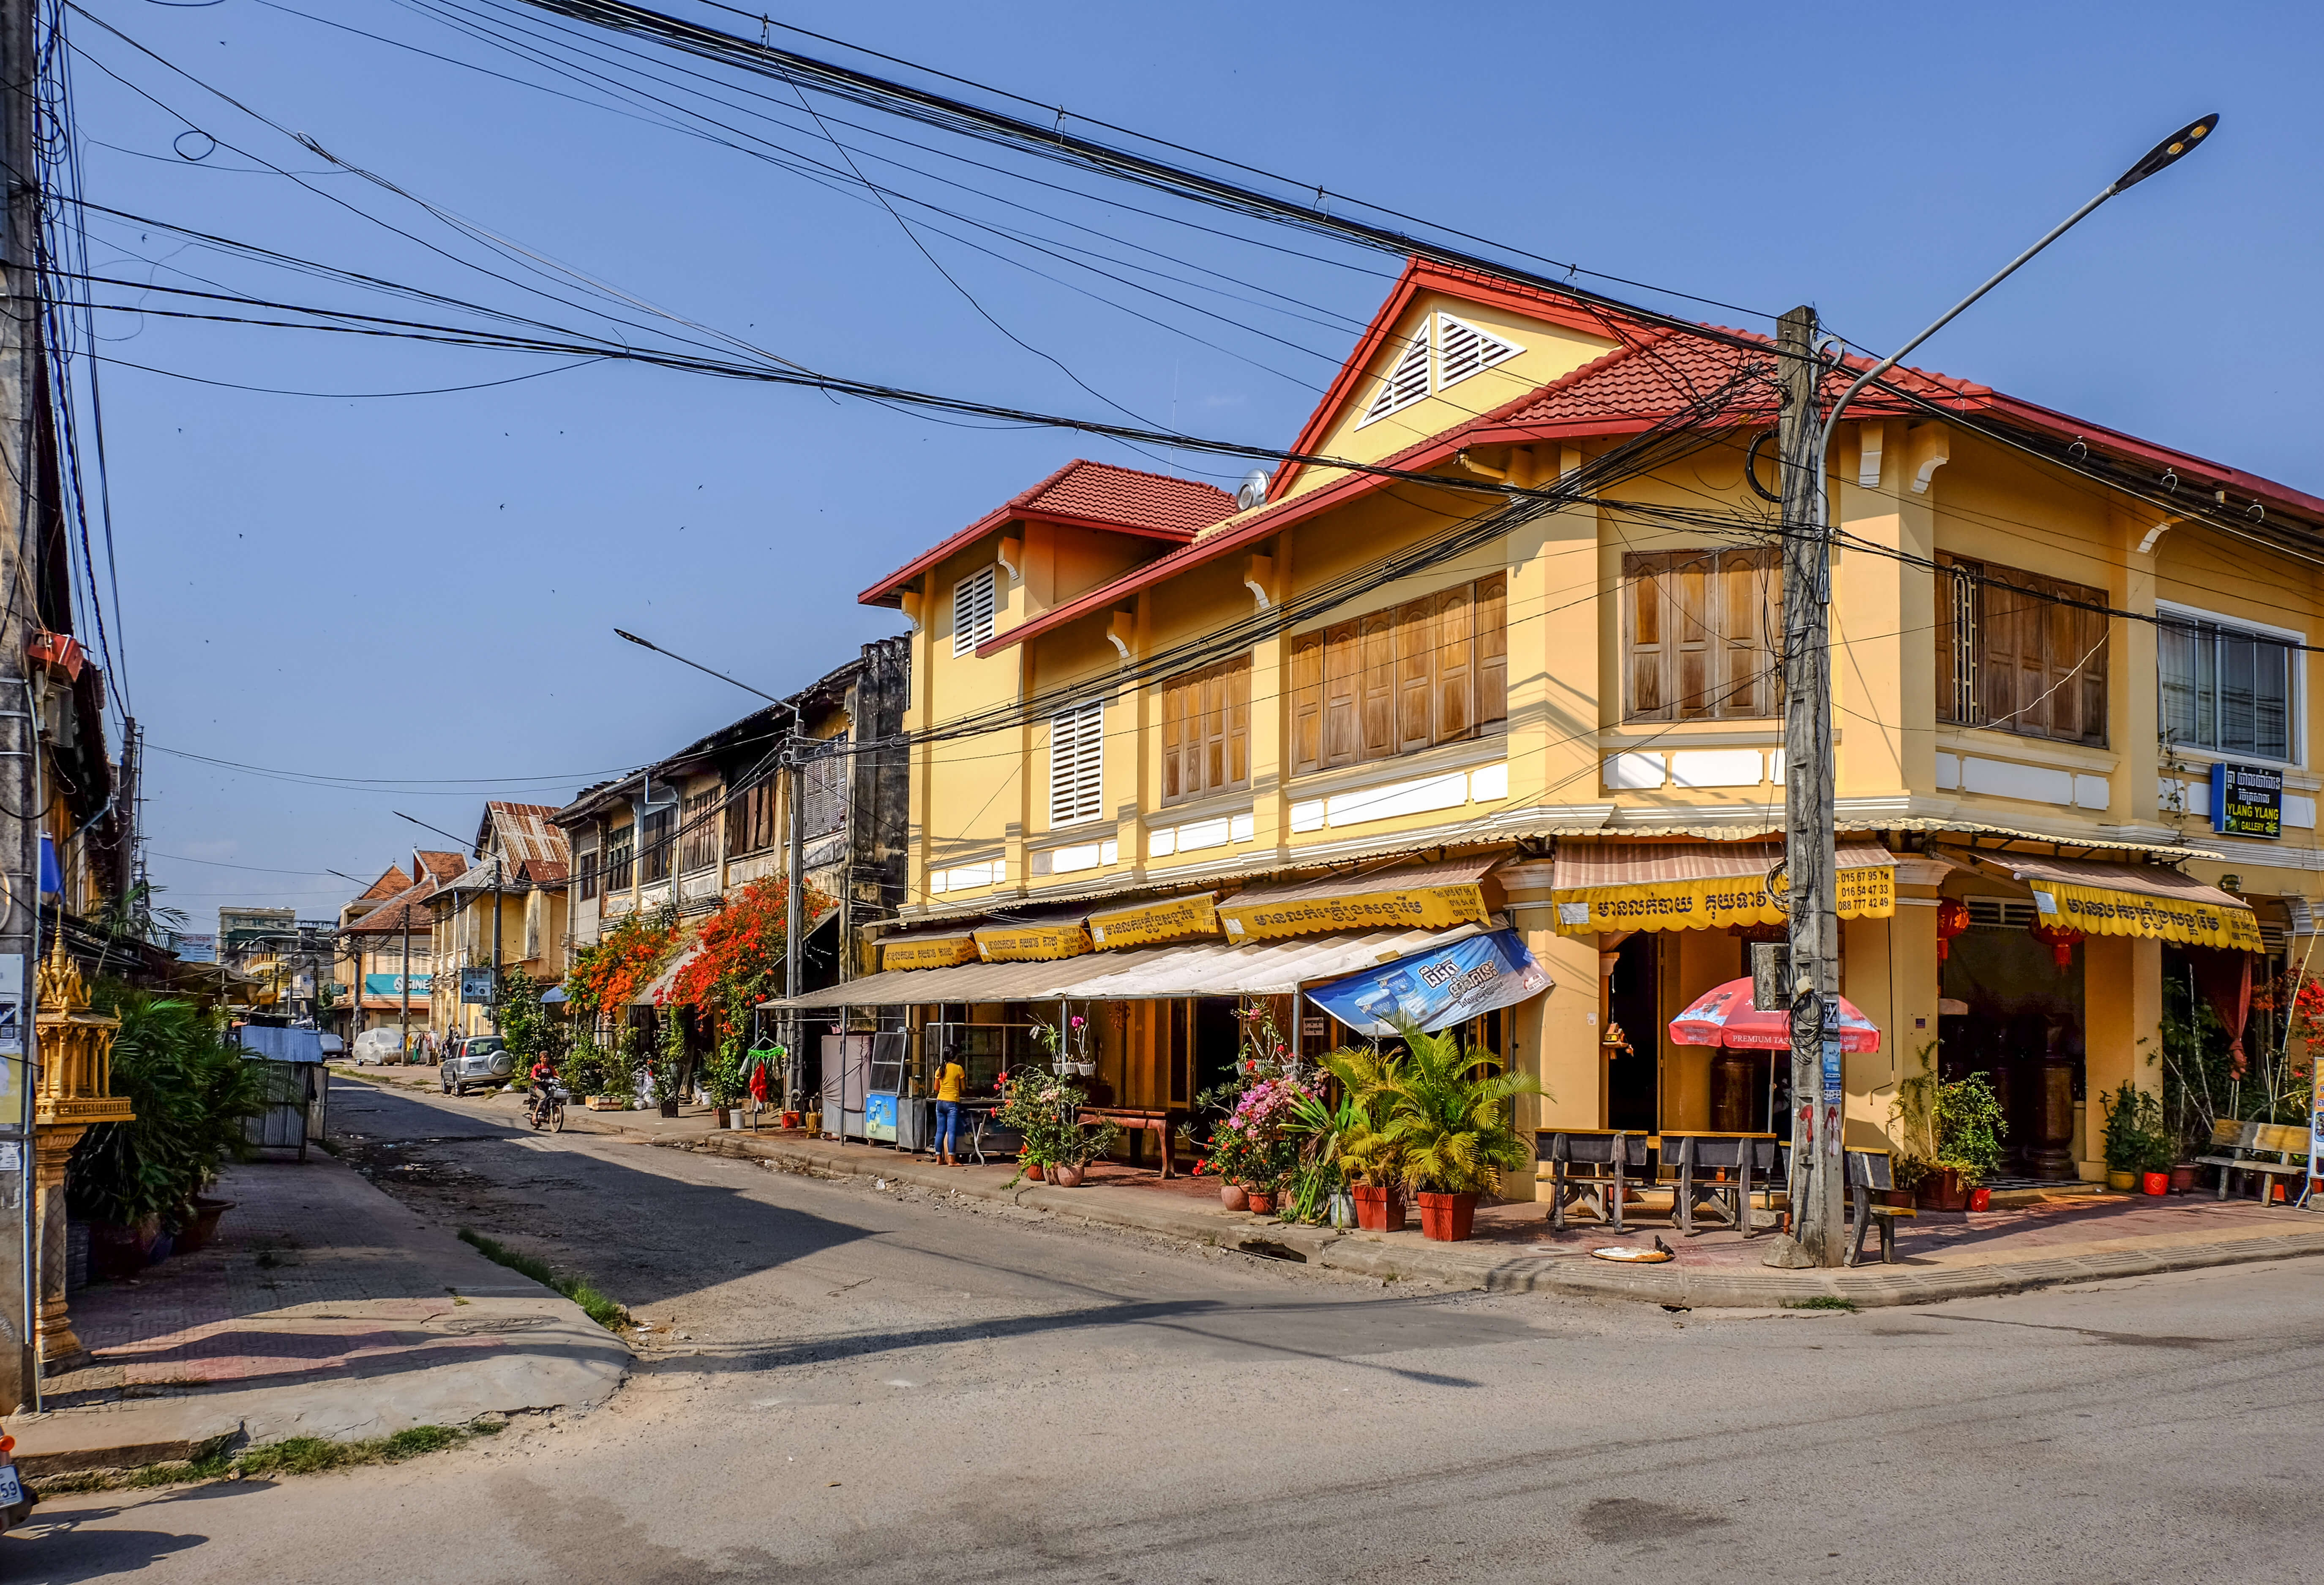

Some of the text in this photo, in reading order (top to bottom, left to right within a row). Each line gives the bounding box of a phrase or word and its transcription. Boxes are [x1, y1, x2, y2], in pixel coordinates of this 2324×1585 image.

[2227, 803, 2279, 820] YLANG YLANG
[2241, 821, 2264, 831] GALLERY
[1841, 873, 1855, 883] 015
[1857, 872, 1866, 882] 67
[1868, 871, 1877, 881] 95
[1842, 884, 1888, 897] 016 54 47 33
[1598, 892, 1693, 917] មានលក់បាយ
[1838, 897, 1888, 911] 088 777 42 49
[1732, 1035, 1772, 1043] PREMIUM
